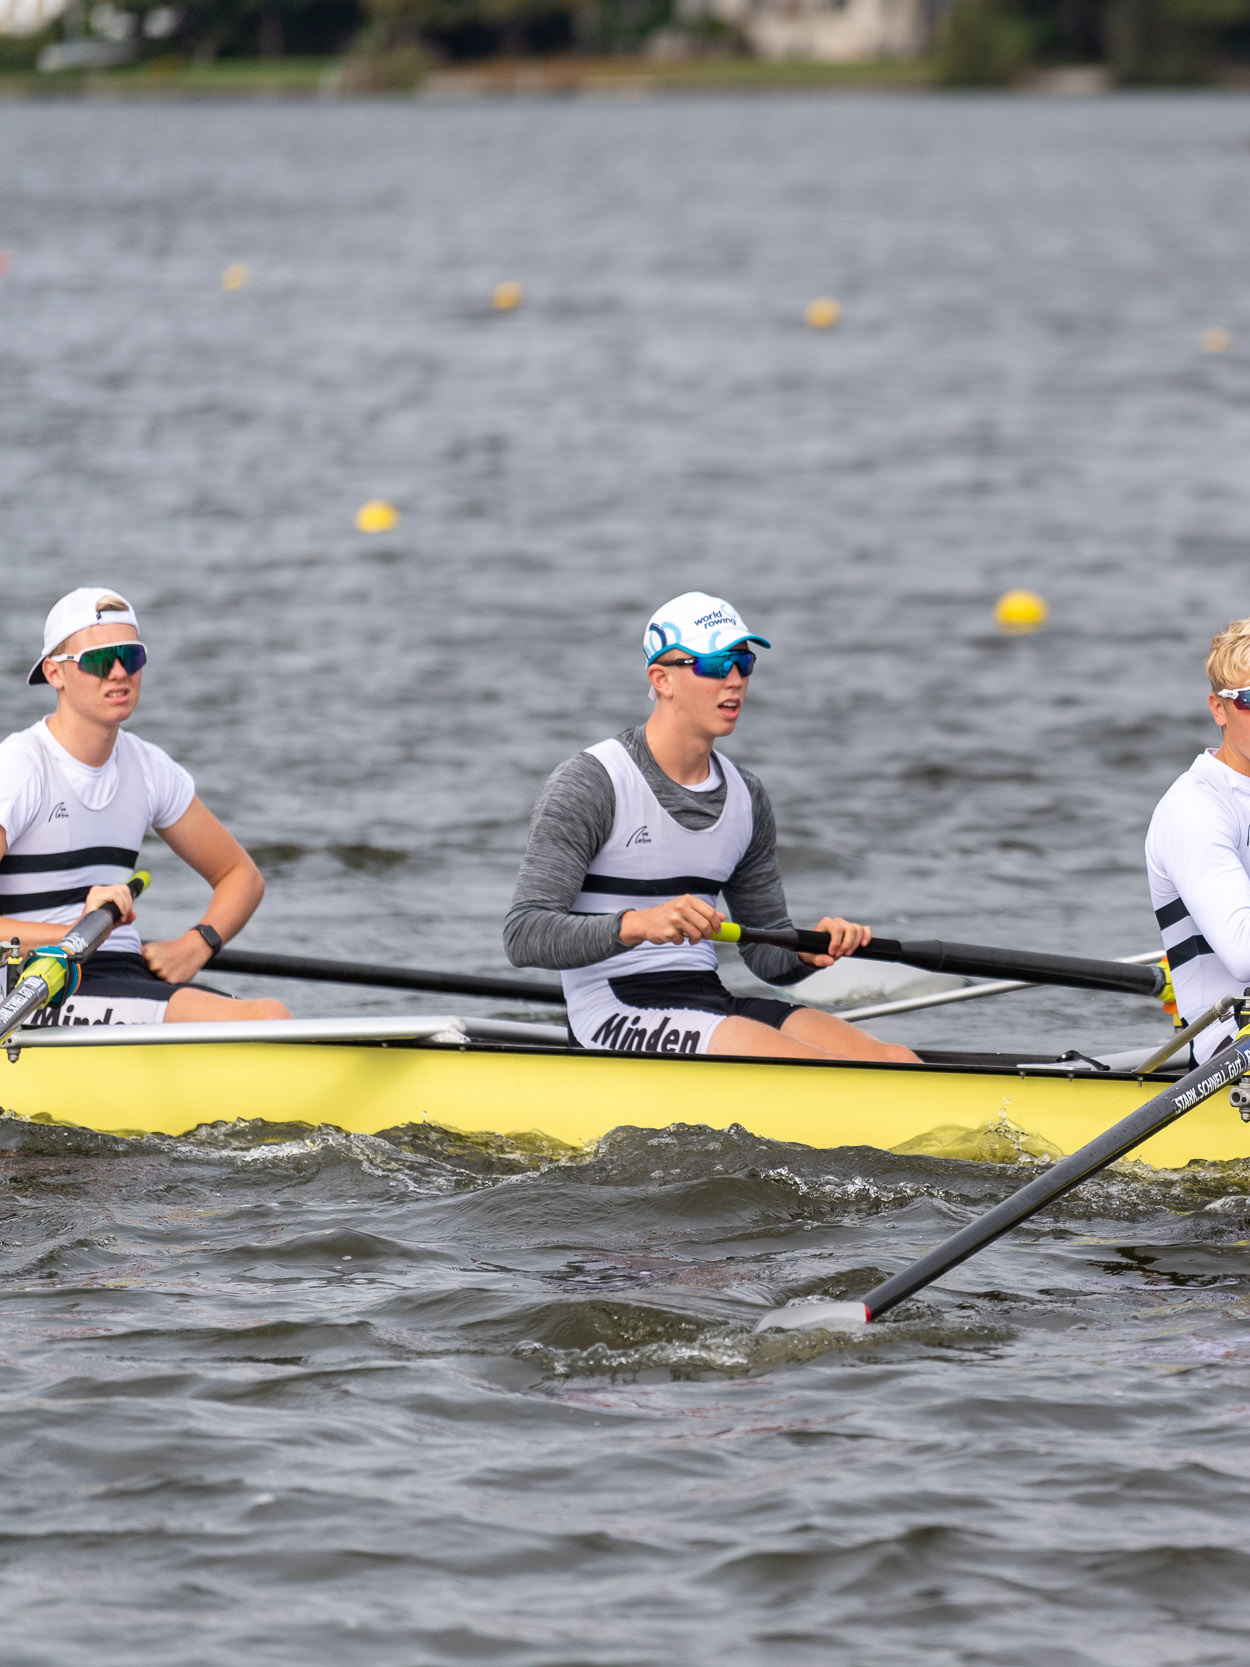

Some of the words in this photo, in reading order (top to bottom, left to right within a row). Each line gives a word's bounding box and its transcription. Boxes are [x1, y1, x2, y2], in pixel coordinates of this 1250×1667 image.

[694, 610, 722, 626] world
[704, 617, 736, 629] rowing
[590, 1013, 701, 1054] Minden
